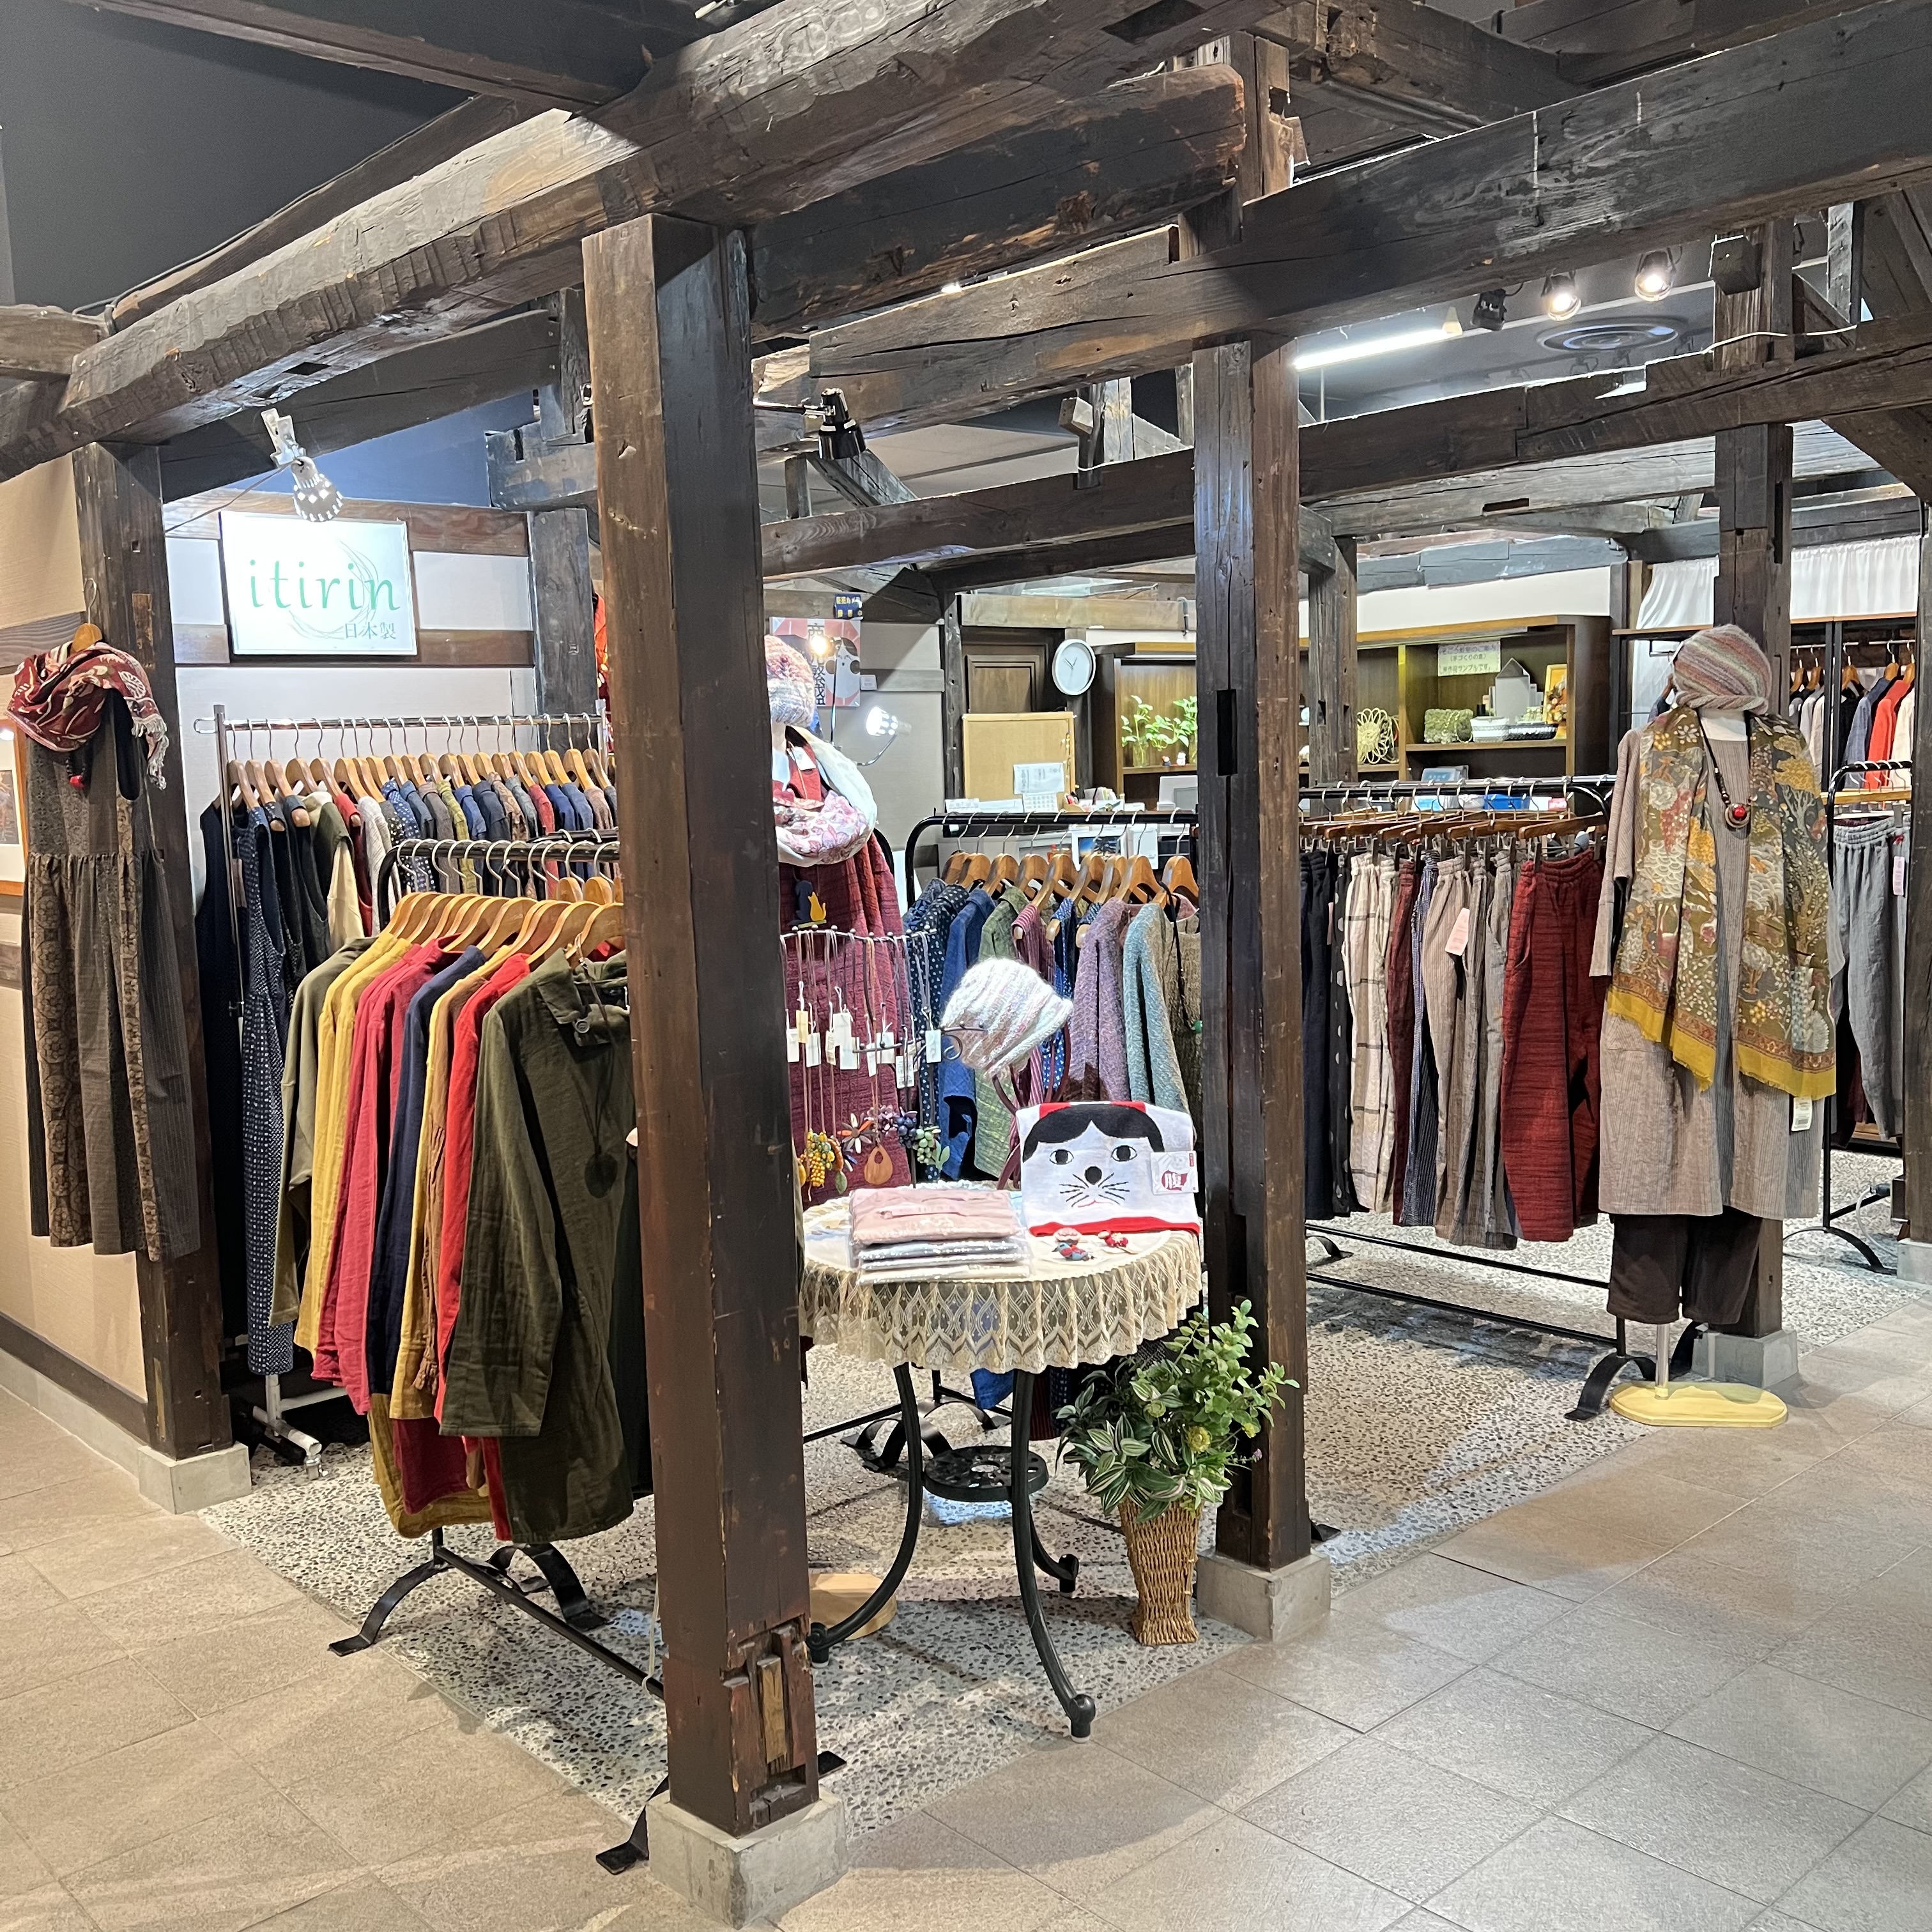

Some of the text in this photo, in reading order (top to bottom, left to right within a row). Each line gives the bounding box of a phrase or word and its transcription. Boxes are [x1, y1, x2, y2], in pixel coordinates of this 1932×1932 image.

[249, 559, 401, 611] itirin
[344, 622, 397, 640] 日本製
